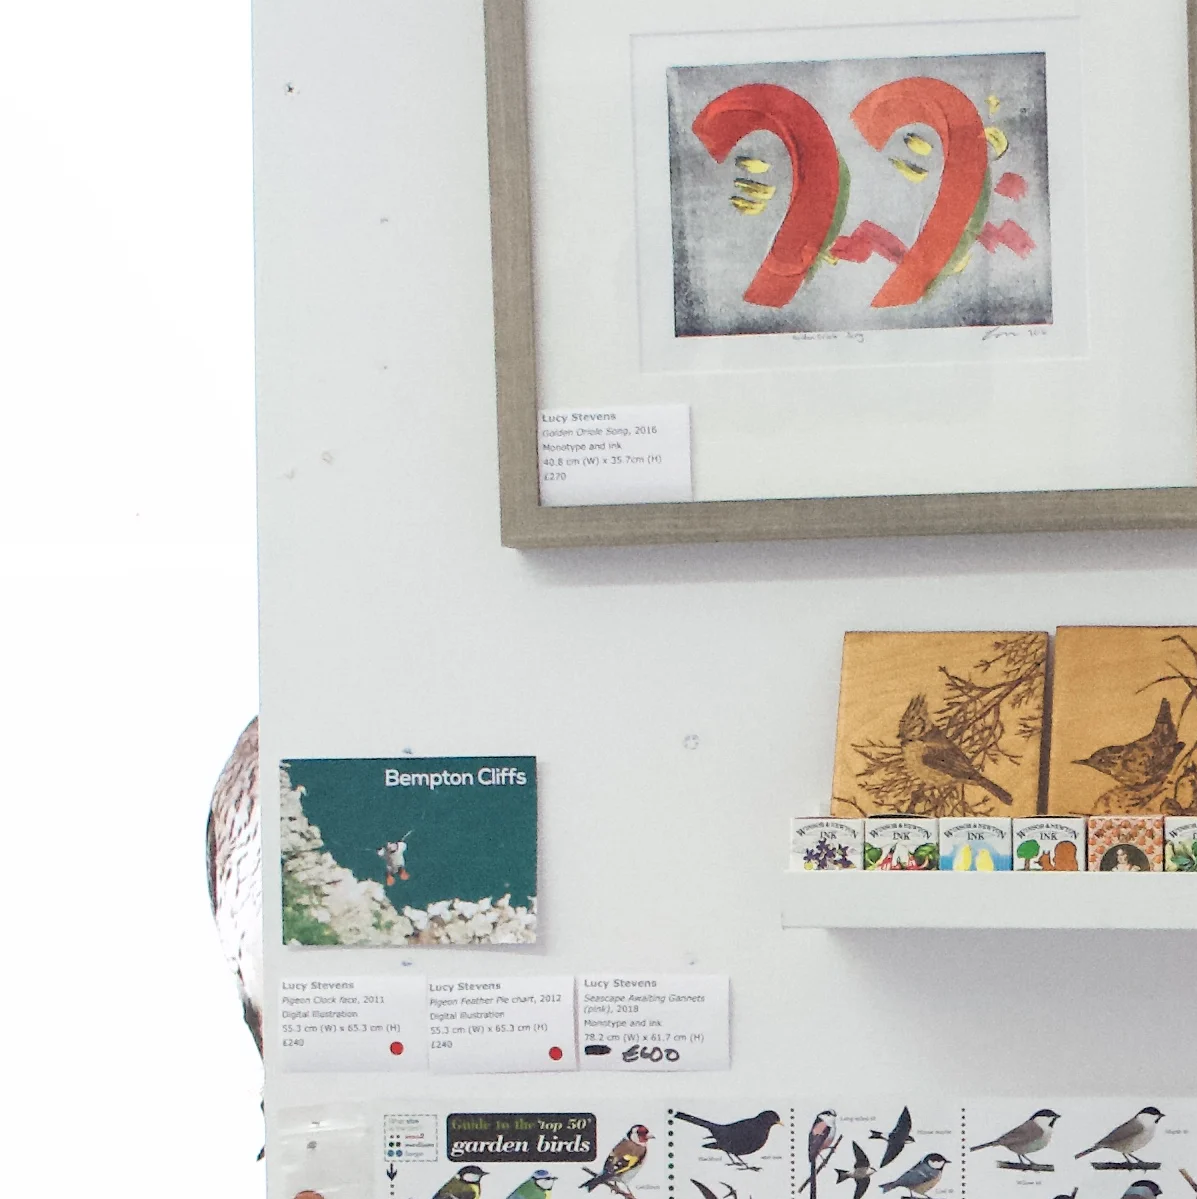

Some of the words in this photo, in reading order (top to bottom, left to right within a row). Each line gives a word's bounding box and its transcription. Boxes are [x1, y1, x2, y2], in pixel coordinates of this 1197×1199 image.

[542, 414, 568, 423] Lucy
[572, 412, 616, 422] Stevens
[543, 429, 573, 437] Golden
[635, 426, 658, 434] 2016
[543, 443, 586, 452] Monotype
[589, 442, 605, 450] and
[609, 442, 622, 450] ink
[566, 458, 580, 466] cm
[583, 457, 600, 466] (W)
[648, 454, 662, 464] (H)
[544, 472, 567, 481] £270
[385, 768, 474, 790] Bempton
[477, 767, 527, 787] Cliffs
[820, 831, 837, 839] INK
[892, 832, 910, 840] INK
[967, 832, 985, 840] INK
[1040, 832, 1058, 840] INK
[282, 981, 308, 991] Lucy
[311, 981, 354, 989] Stevens
[429, 984, 454, 992] Lucy
[458, 982, 501, 991] Stevens
[584, 979, 609, 989] Lucy
[613, 979, 657, 988] Stevens
[540, 994, 562, 1003] 2012
[617, 1004, 639, 1013] 2018
[282, 1010, 310, 1020] Digital
[430, 1012, 457, 1022] Digital
[320, 1024, 336, 1033] (W)
[386, 1024, 401, 1033] (H)
[584, 1020, 626, 1028] Monotype
[630, 1019, 646, 1027] and
[468, 1025, 484, 1035] (W)
[533, 1023, 548, 1032] (H)
[623, 1033, 640, 1042] (W)
[690, 1033, 704, 1043] (H)
[451, 1118, 491, 1131] Guide
[496, 1120, 509, 1131] to
[514, 1118, 535, 1131] the
[450, 1134, 530, 1158] garden
[537, 1134, 591, 1154] birds
